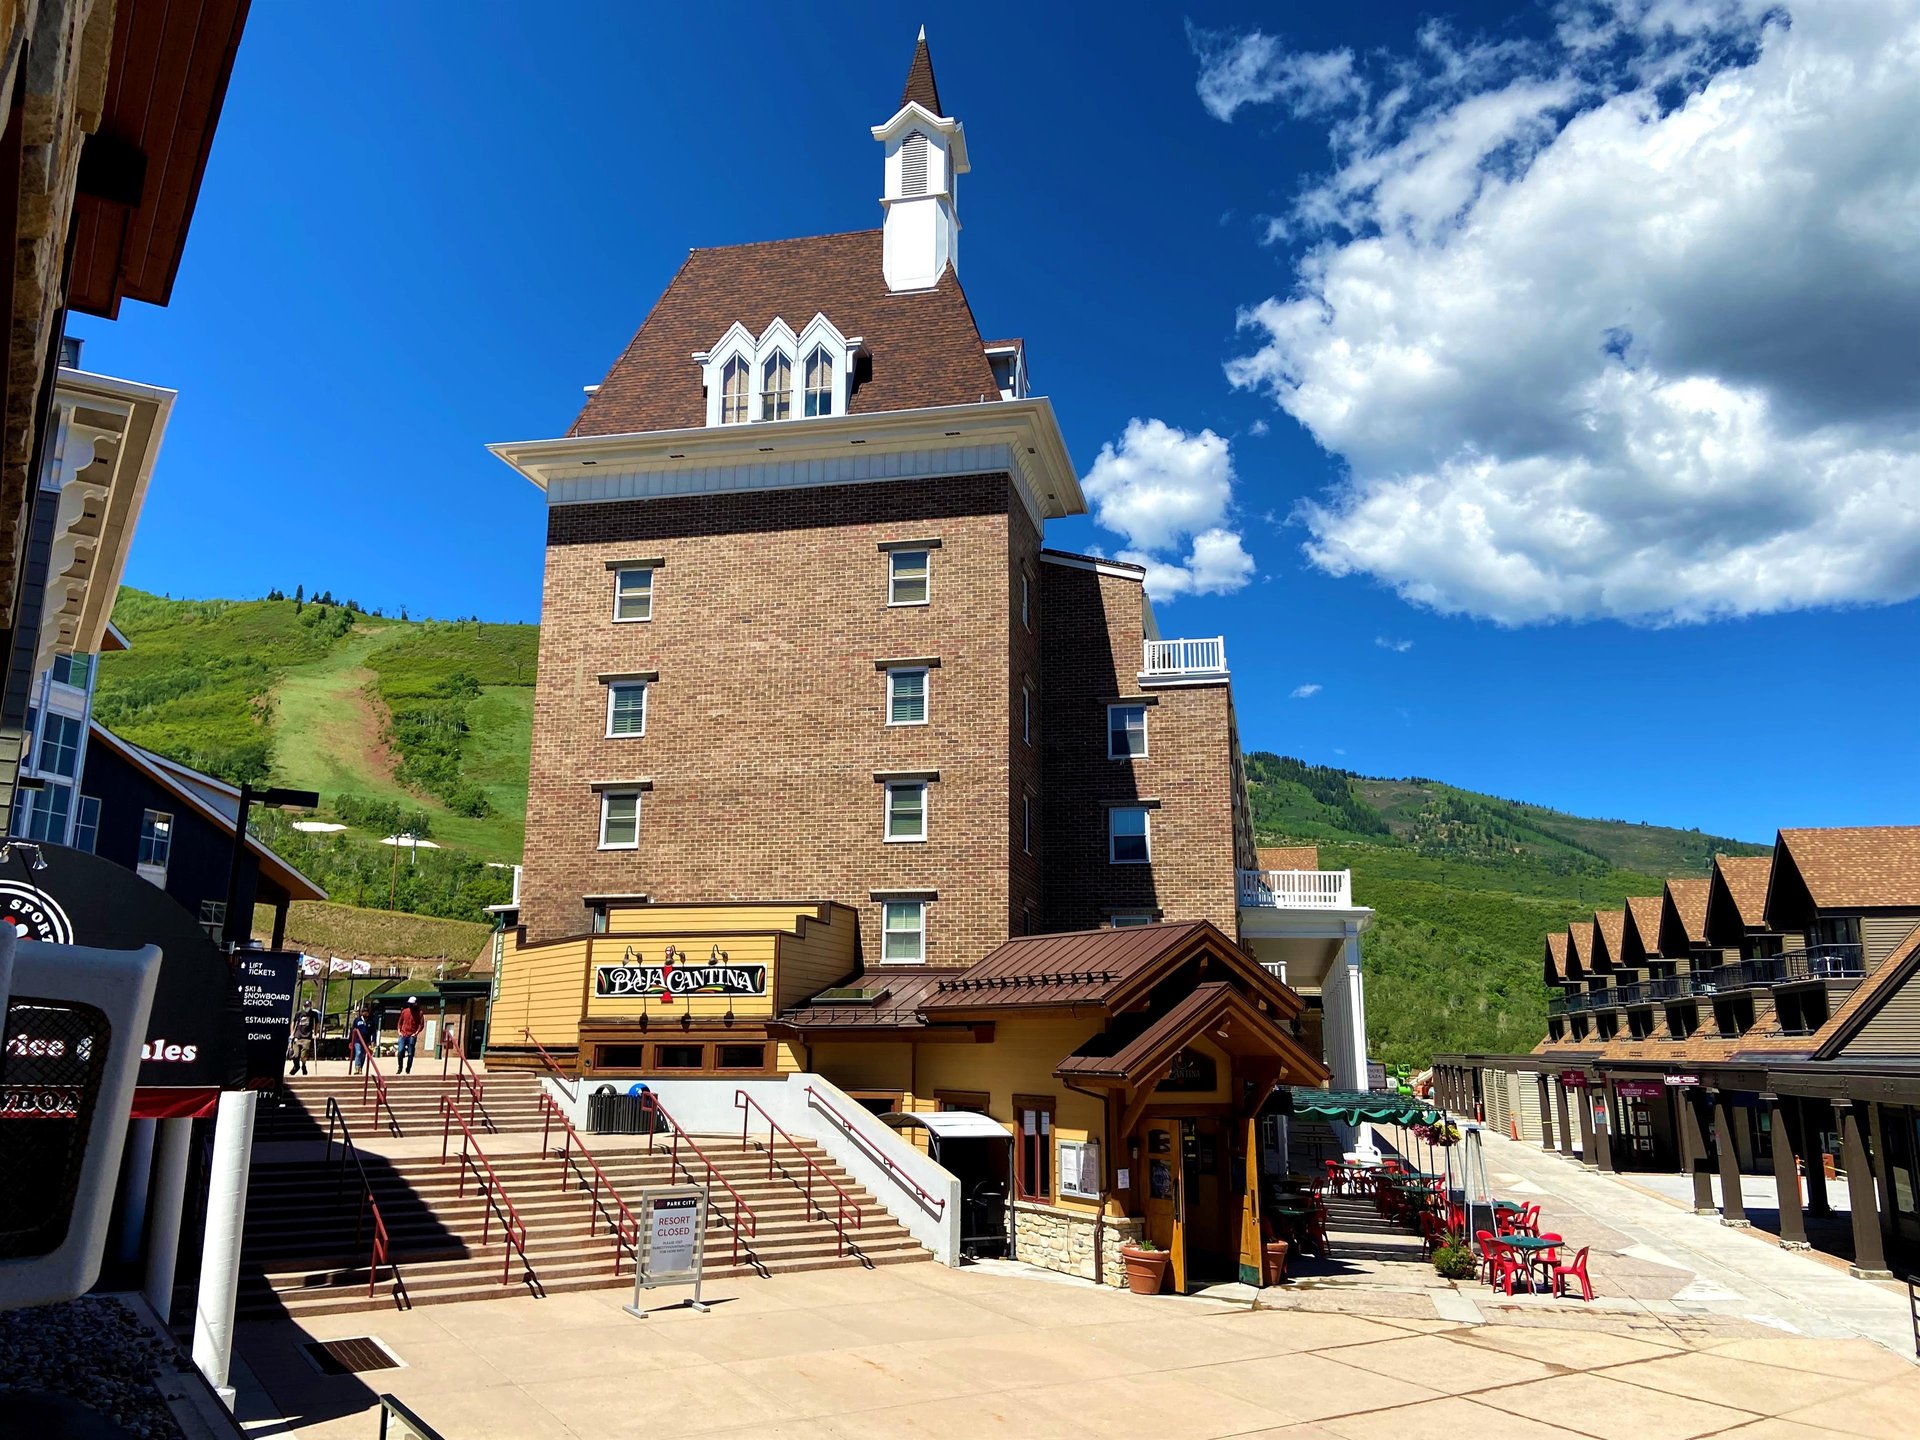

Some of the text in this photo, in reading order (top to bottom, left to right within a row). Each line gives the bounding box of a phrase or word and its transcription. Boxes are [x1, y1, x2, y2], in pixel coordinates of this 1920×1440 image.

[248, 969, 276, 977] TICKETS
[610, 967, 756, 994] BAJA CANTINA
[243, 992, 290, 1001] SNOWBOARD
[243, 999, 274, 1007] SCHOOL
[244, 1016, 290, 1025] ESTAURANTS
[247, 1033, 272, 1041] DGING
[141, 1039, 198, 1062] ales
[658, 1216, 690, 1225] RESORT
[657, 1227, 690, 1237] CLOSED
